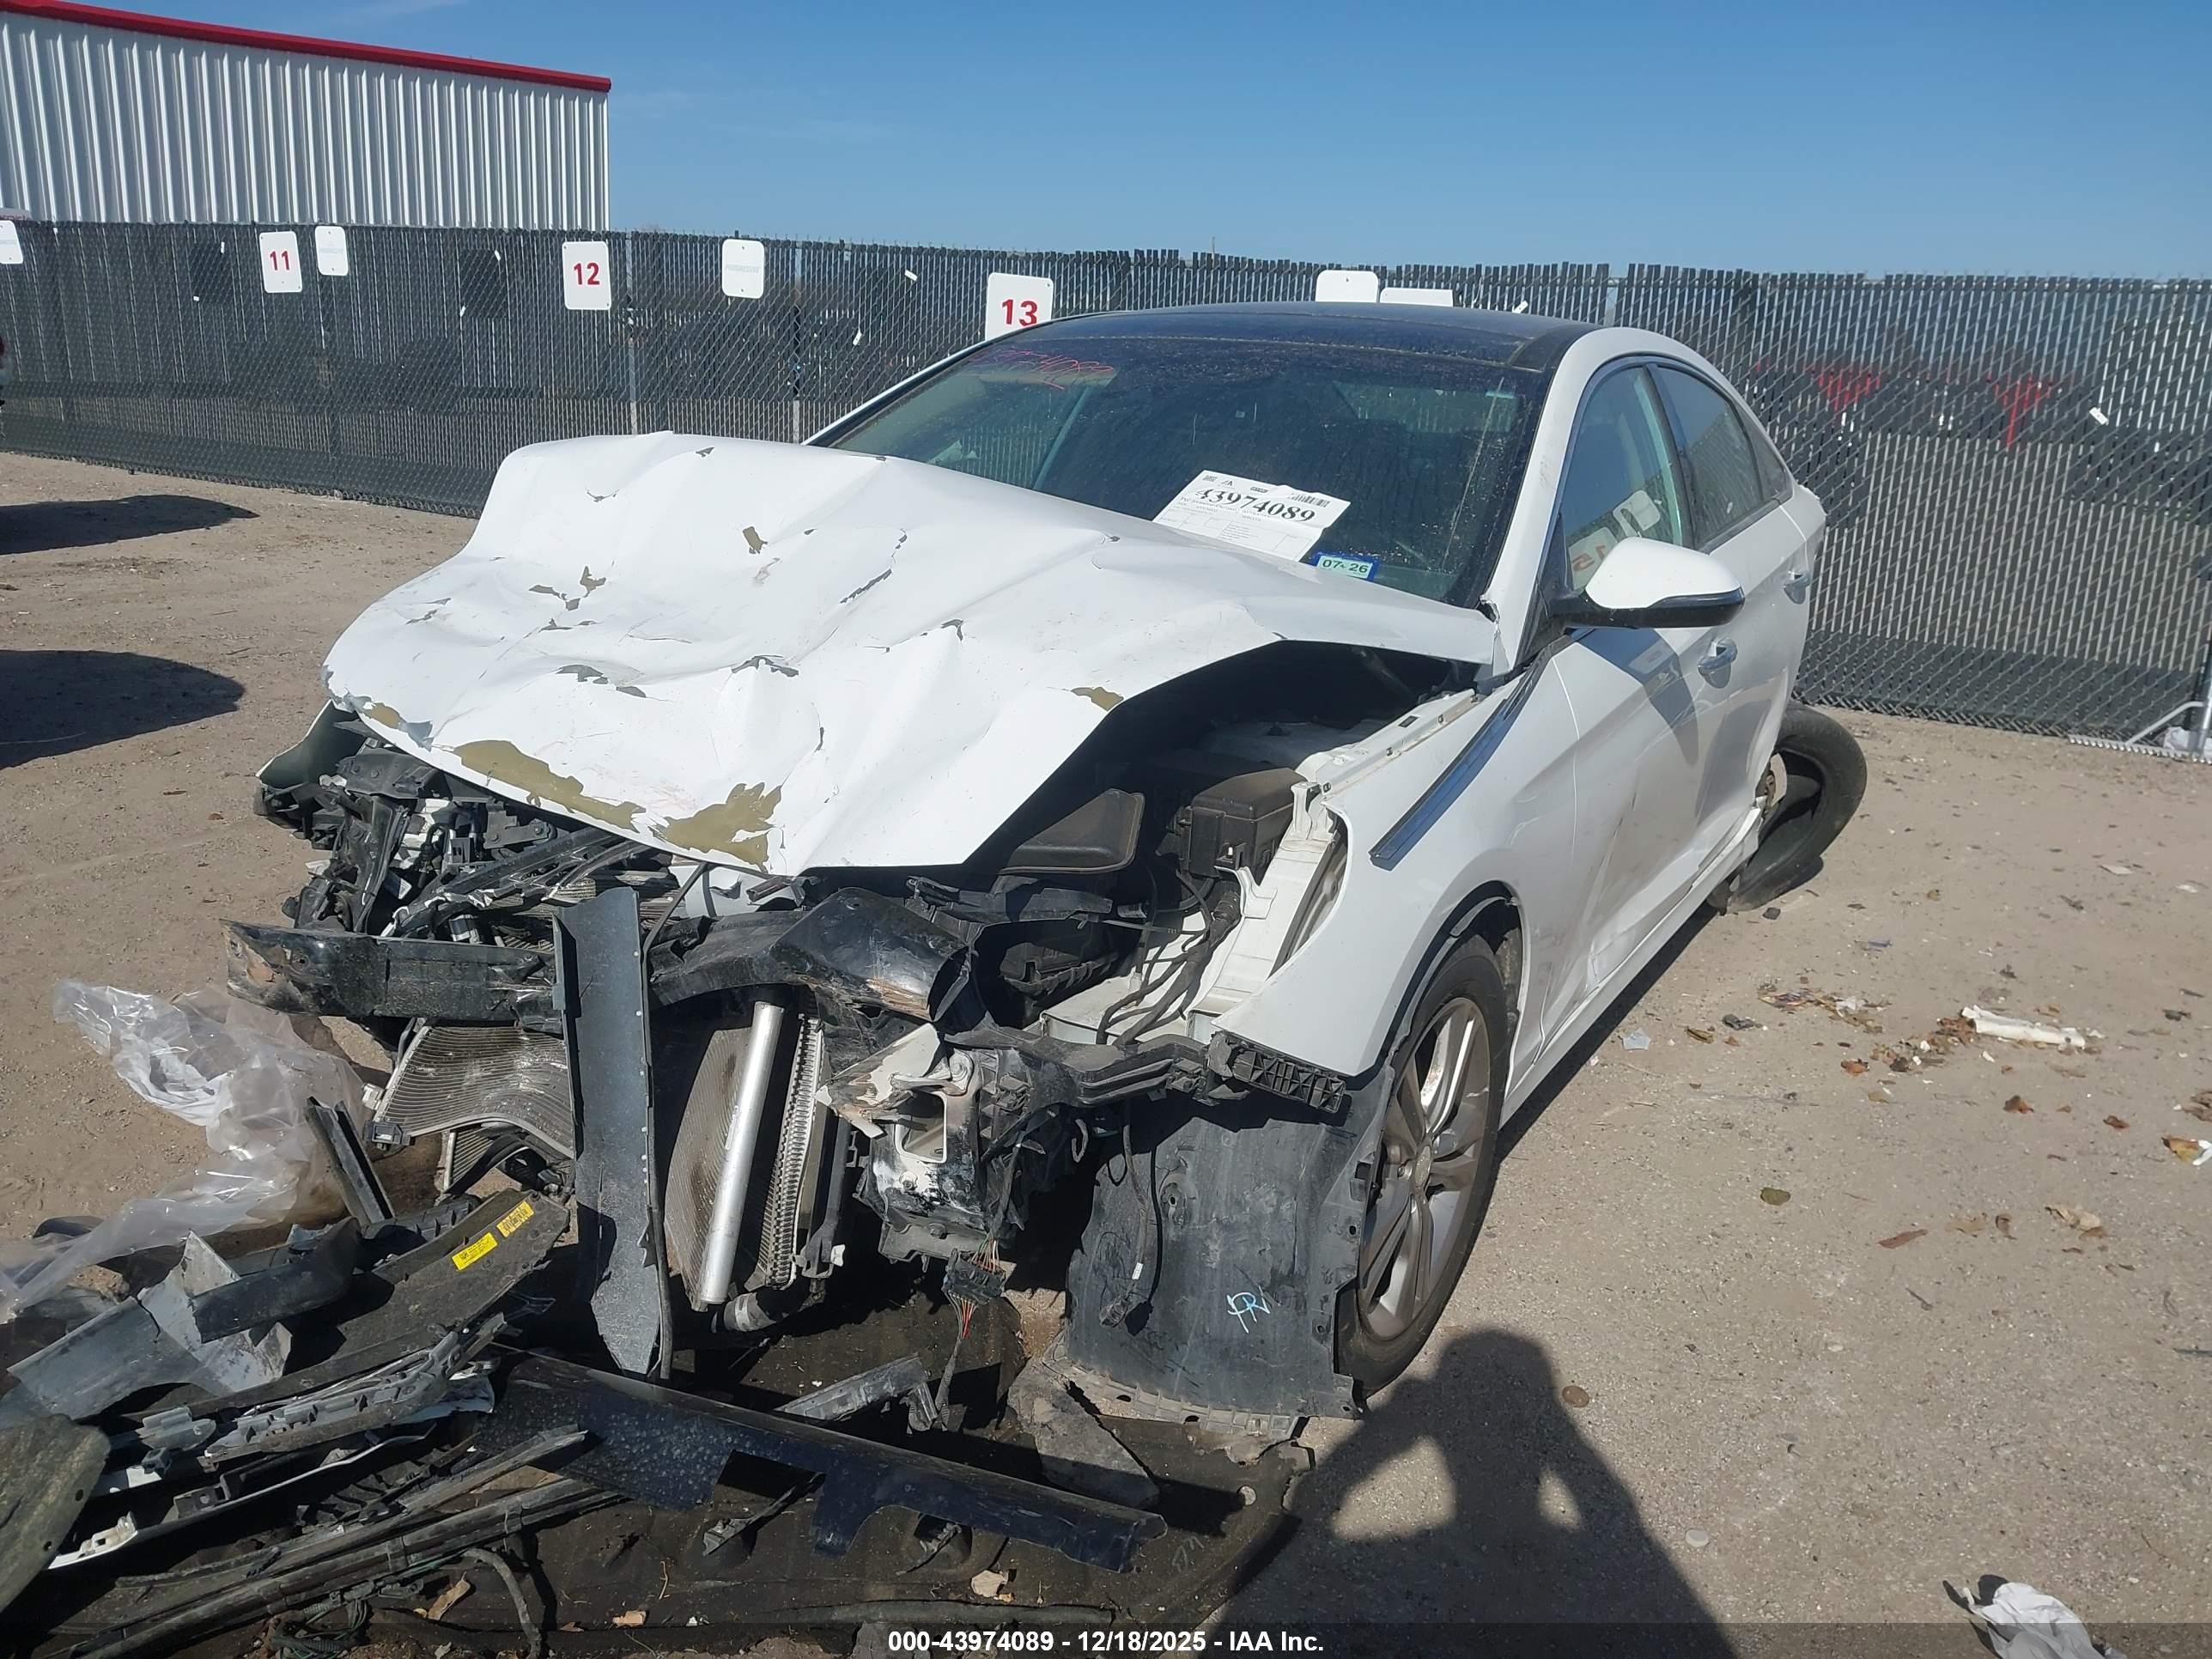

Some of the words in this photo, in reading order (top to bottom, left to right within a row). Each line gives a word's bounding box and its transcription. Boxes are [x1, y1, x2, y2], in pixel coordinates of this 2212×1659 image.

[270, 250, 290, 271] 11
[573, 261, 601, 286] 12
[1001, 298, 1038, 327] 13
[1194, 488, 1316, 522] 43974089
[1348, 562, 1369, 573] 26
